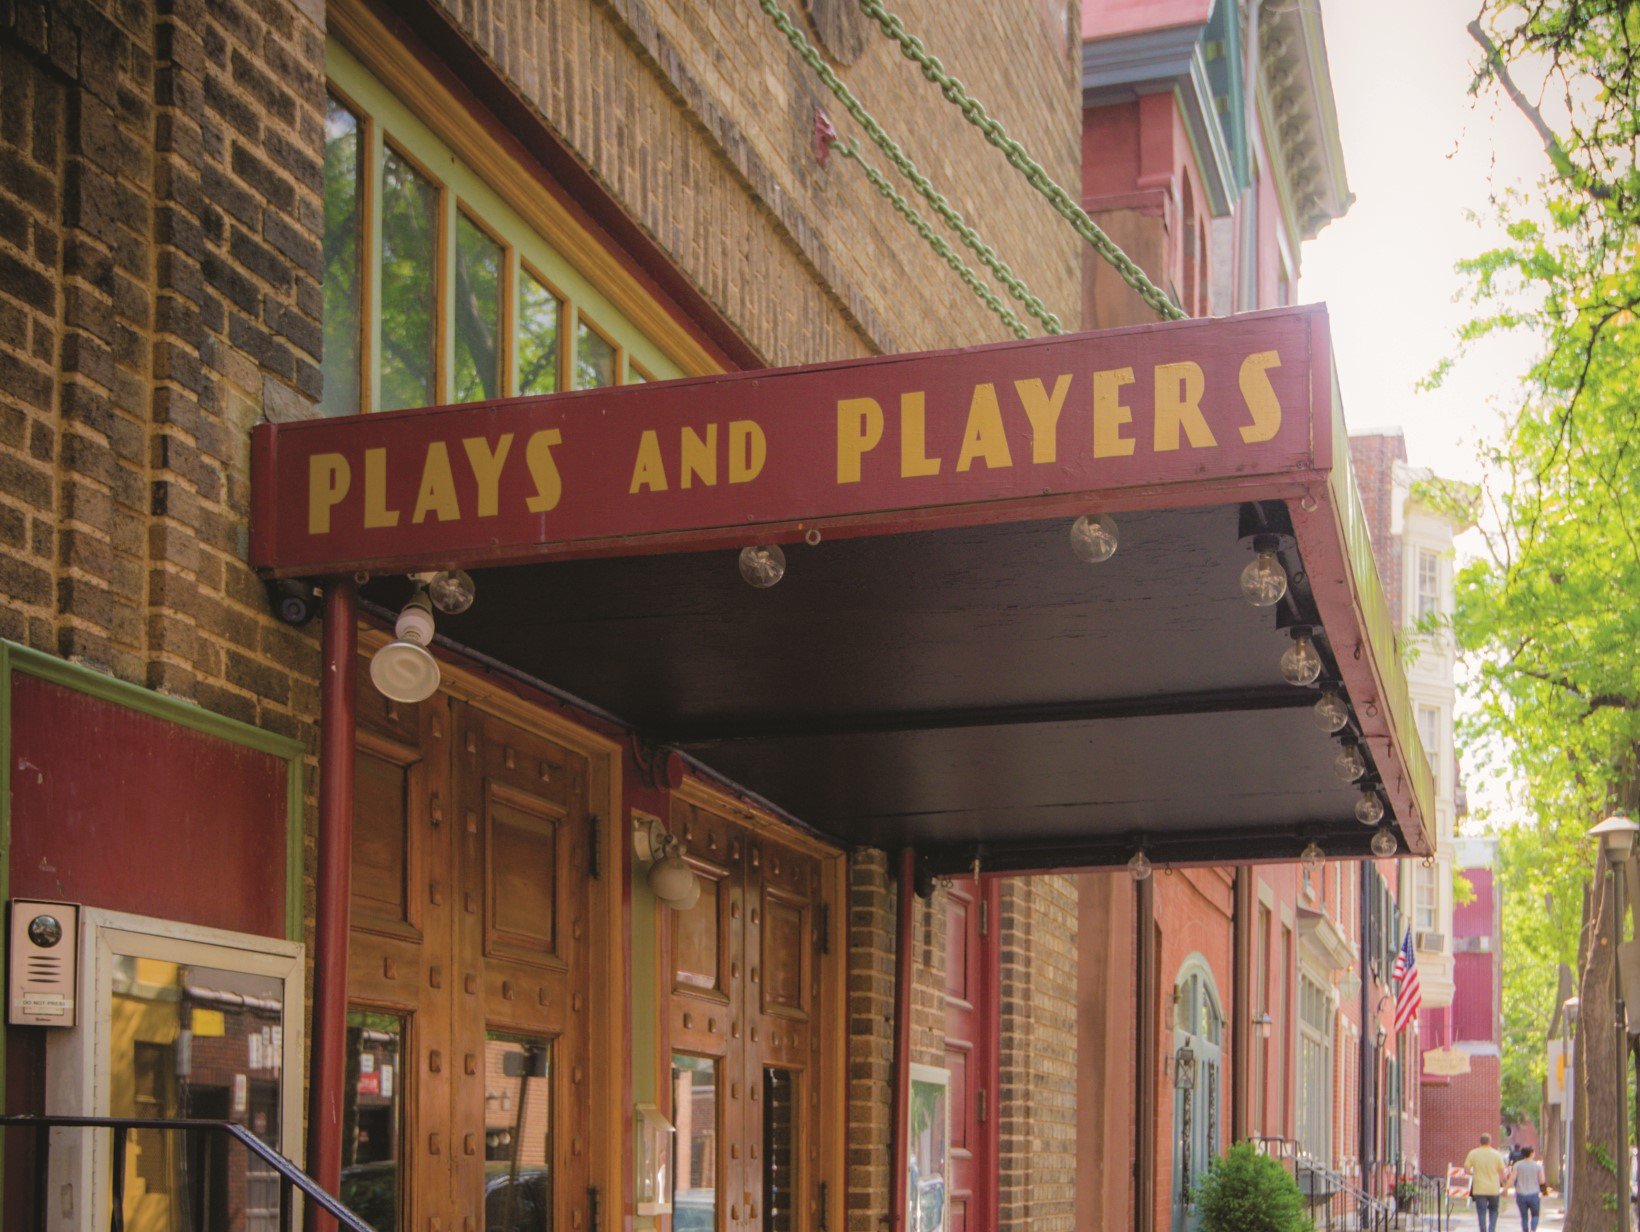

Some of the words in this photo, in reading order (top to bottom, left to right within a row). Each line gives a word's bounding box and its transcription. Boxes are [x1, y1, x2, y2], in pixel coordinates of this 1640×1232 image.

[308, 429, 562, 535] PLAYS
[629, 420, 767, 494] AND
[836, 350, 1282, 484] PLAYERS
